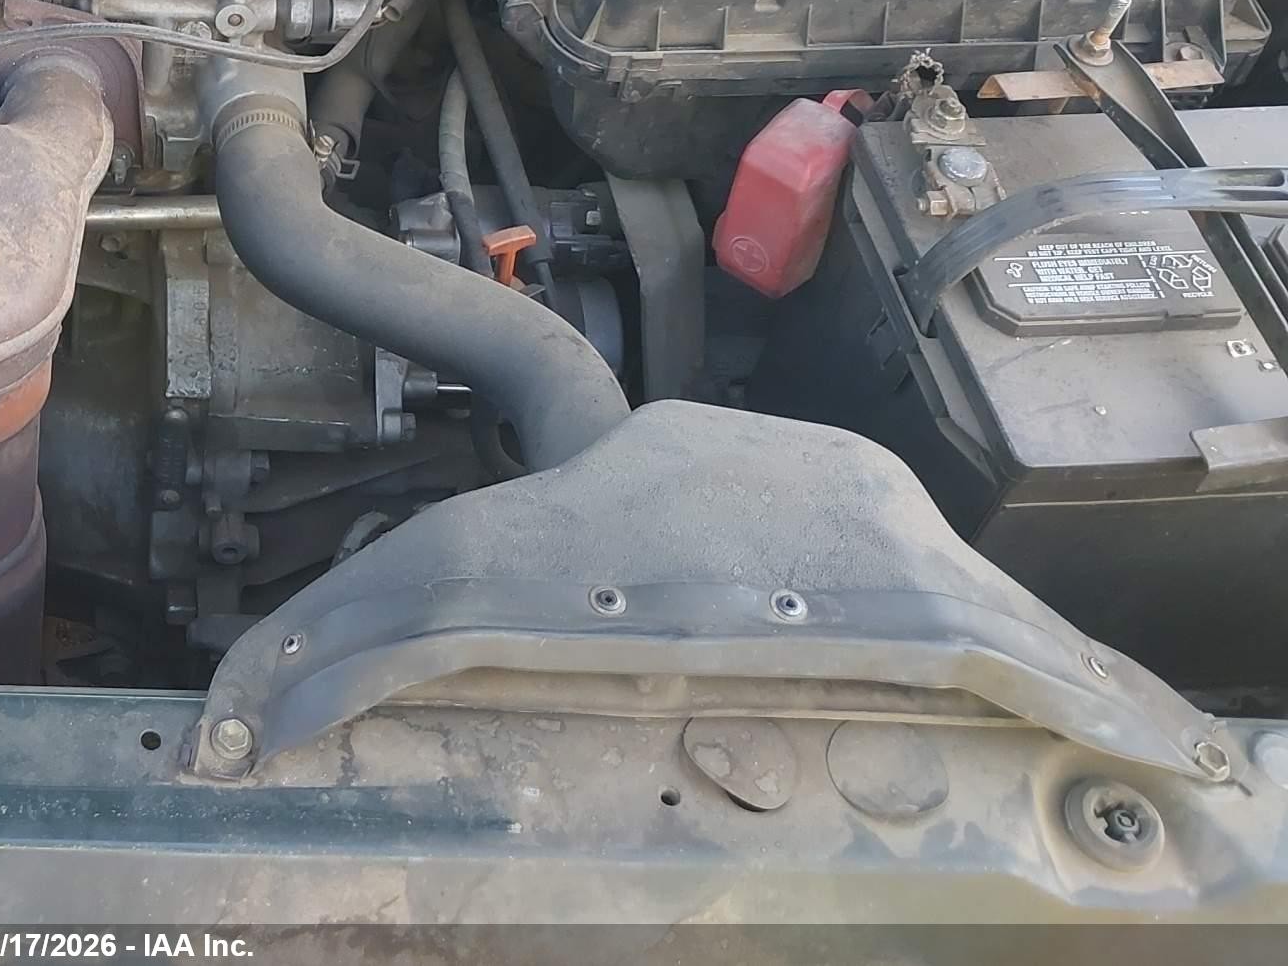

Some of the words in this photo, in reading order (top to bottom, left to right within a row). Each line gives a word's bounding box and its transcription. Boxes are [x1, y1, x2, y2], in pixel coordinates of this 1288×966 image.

[1032, 260, 1058, 268] FLUSH
[1057, 259, 1079, 267] EYES
[1078, 257, 1129, 266] IMMEDIATELY
[1094, 272, 1115, 280] FAST
